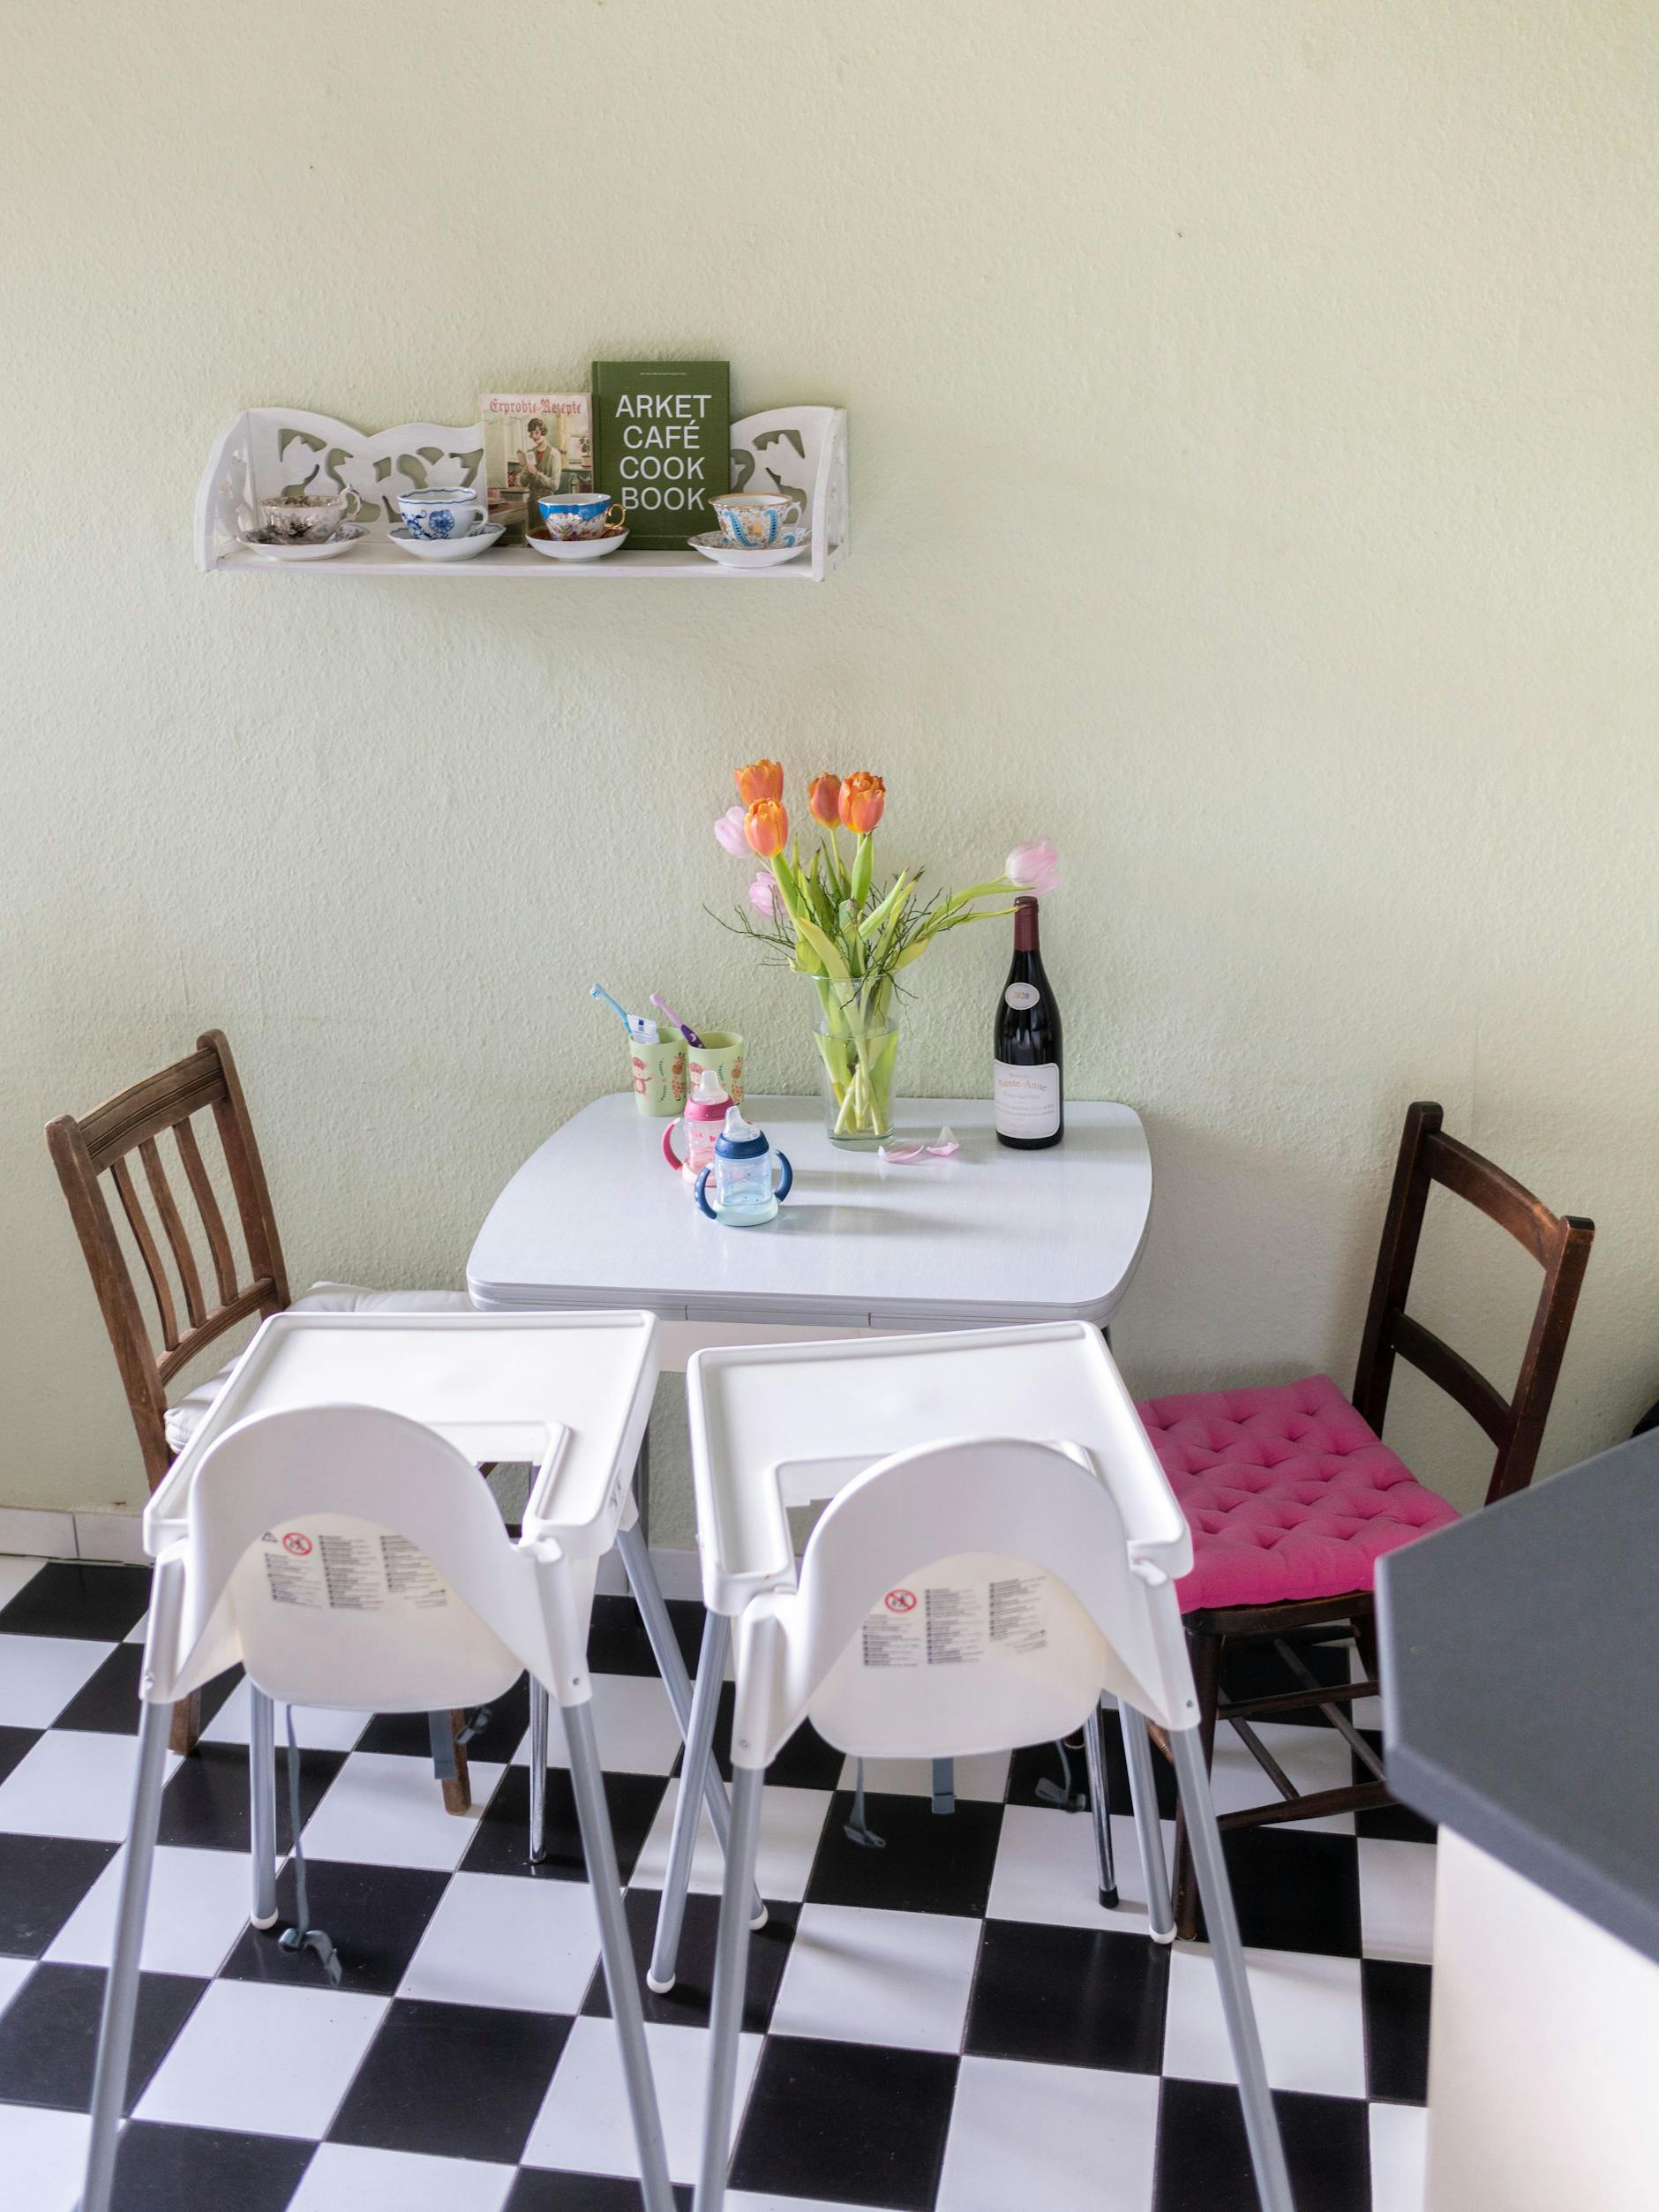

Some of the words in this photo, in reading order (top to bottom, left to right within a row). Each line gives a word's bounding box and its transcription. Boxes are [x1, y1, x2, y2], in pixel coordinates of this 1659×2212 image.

[489, 398, 537, 415] Erprobte
[540, 398, 582, 418] Rezepte
[615, 395, 712, 418] ARKET
[623, 419, 701, 449] CAFÉ
[619, 455, 706, 480] COOK
[621, 486, 706, 511] BOOK
